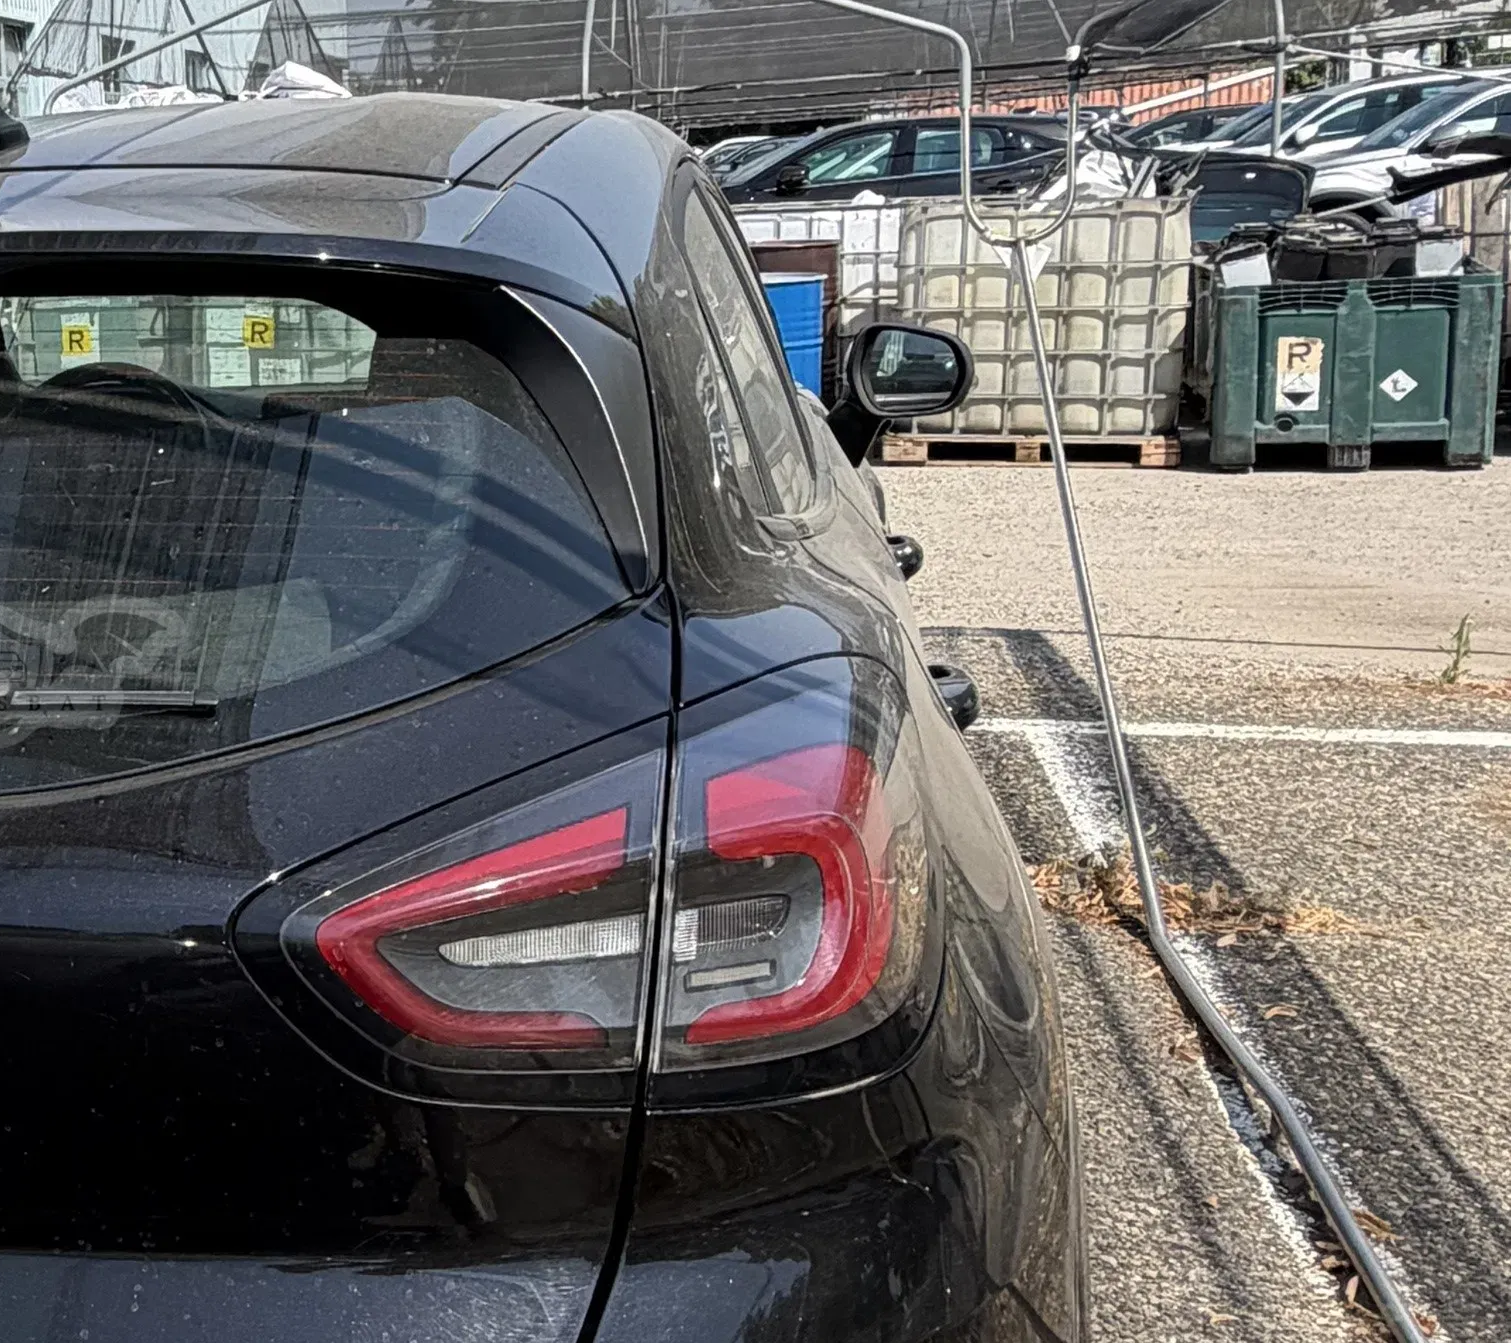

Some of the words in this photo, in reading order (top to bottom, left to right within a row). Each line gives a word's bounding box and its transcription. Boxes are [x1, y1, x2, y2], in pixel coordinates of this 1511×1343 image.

[68, 330, 85, 352] R
[251, 321, 269, 344] R
[1288, 342, 1312, 370] R
